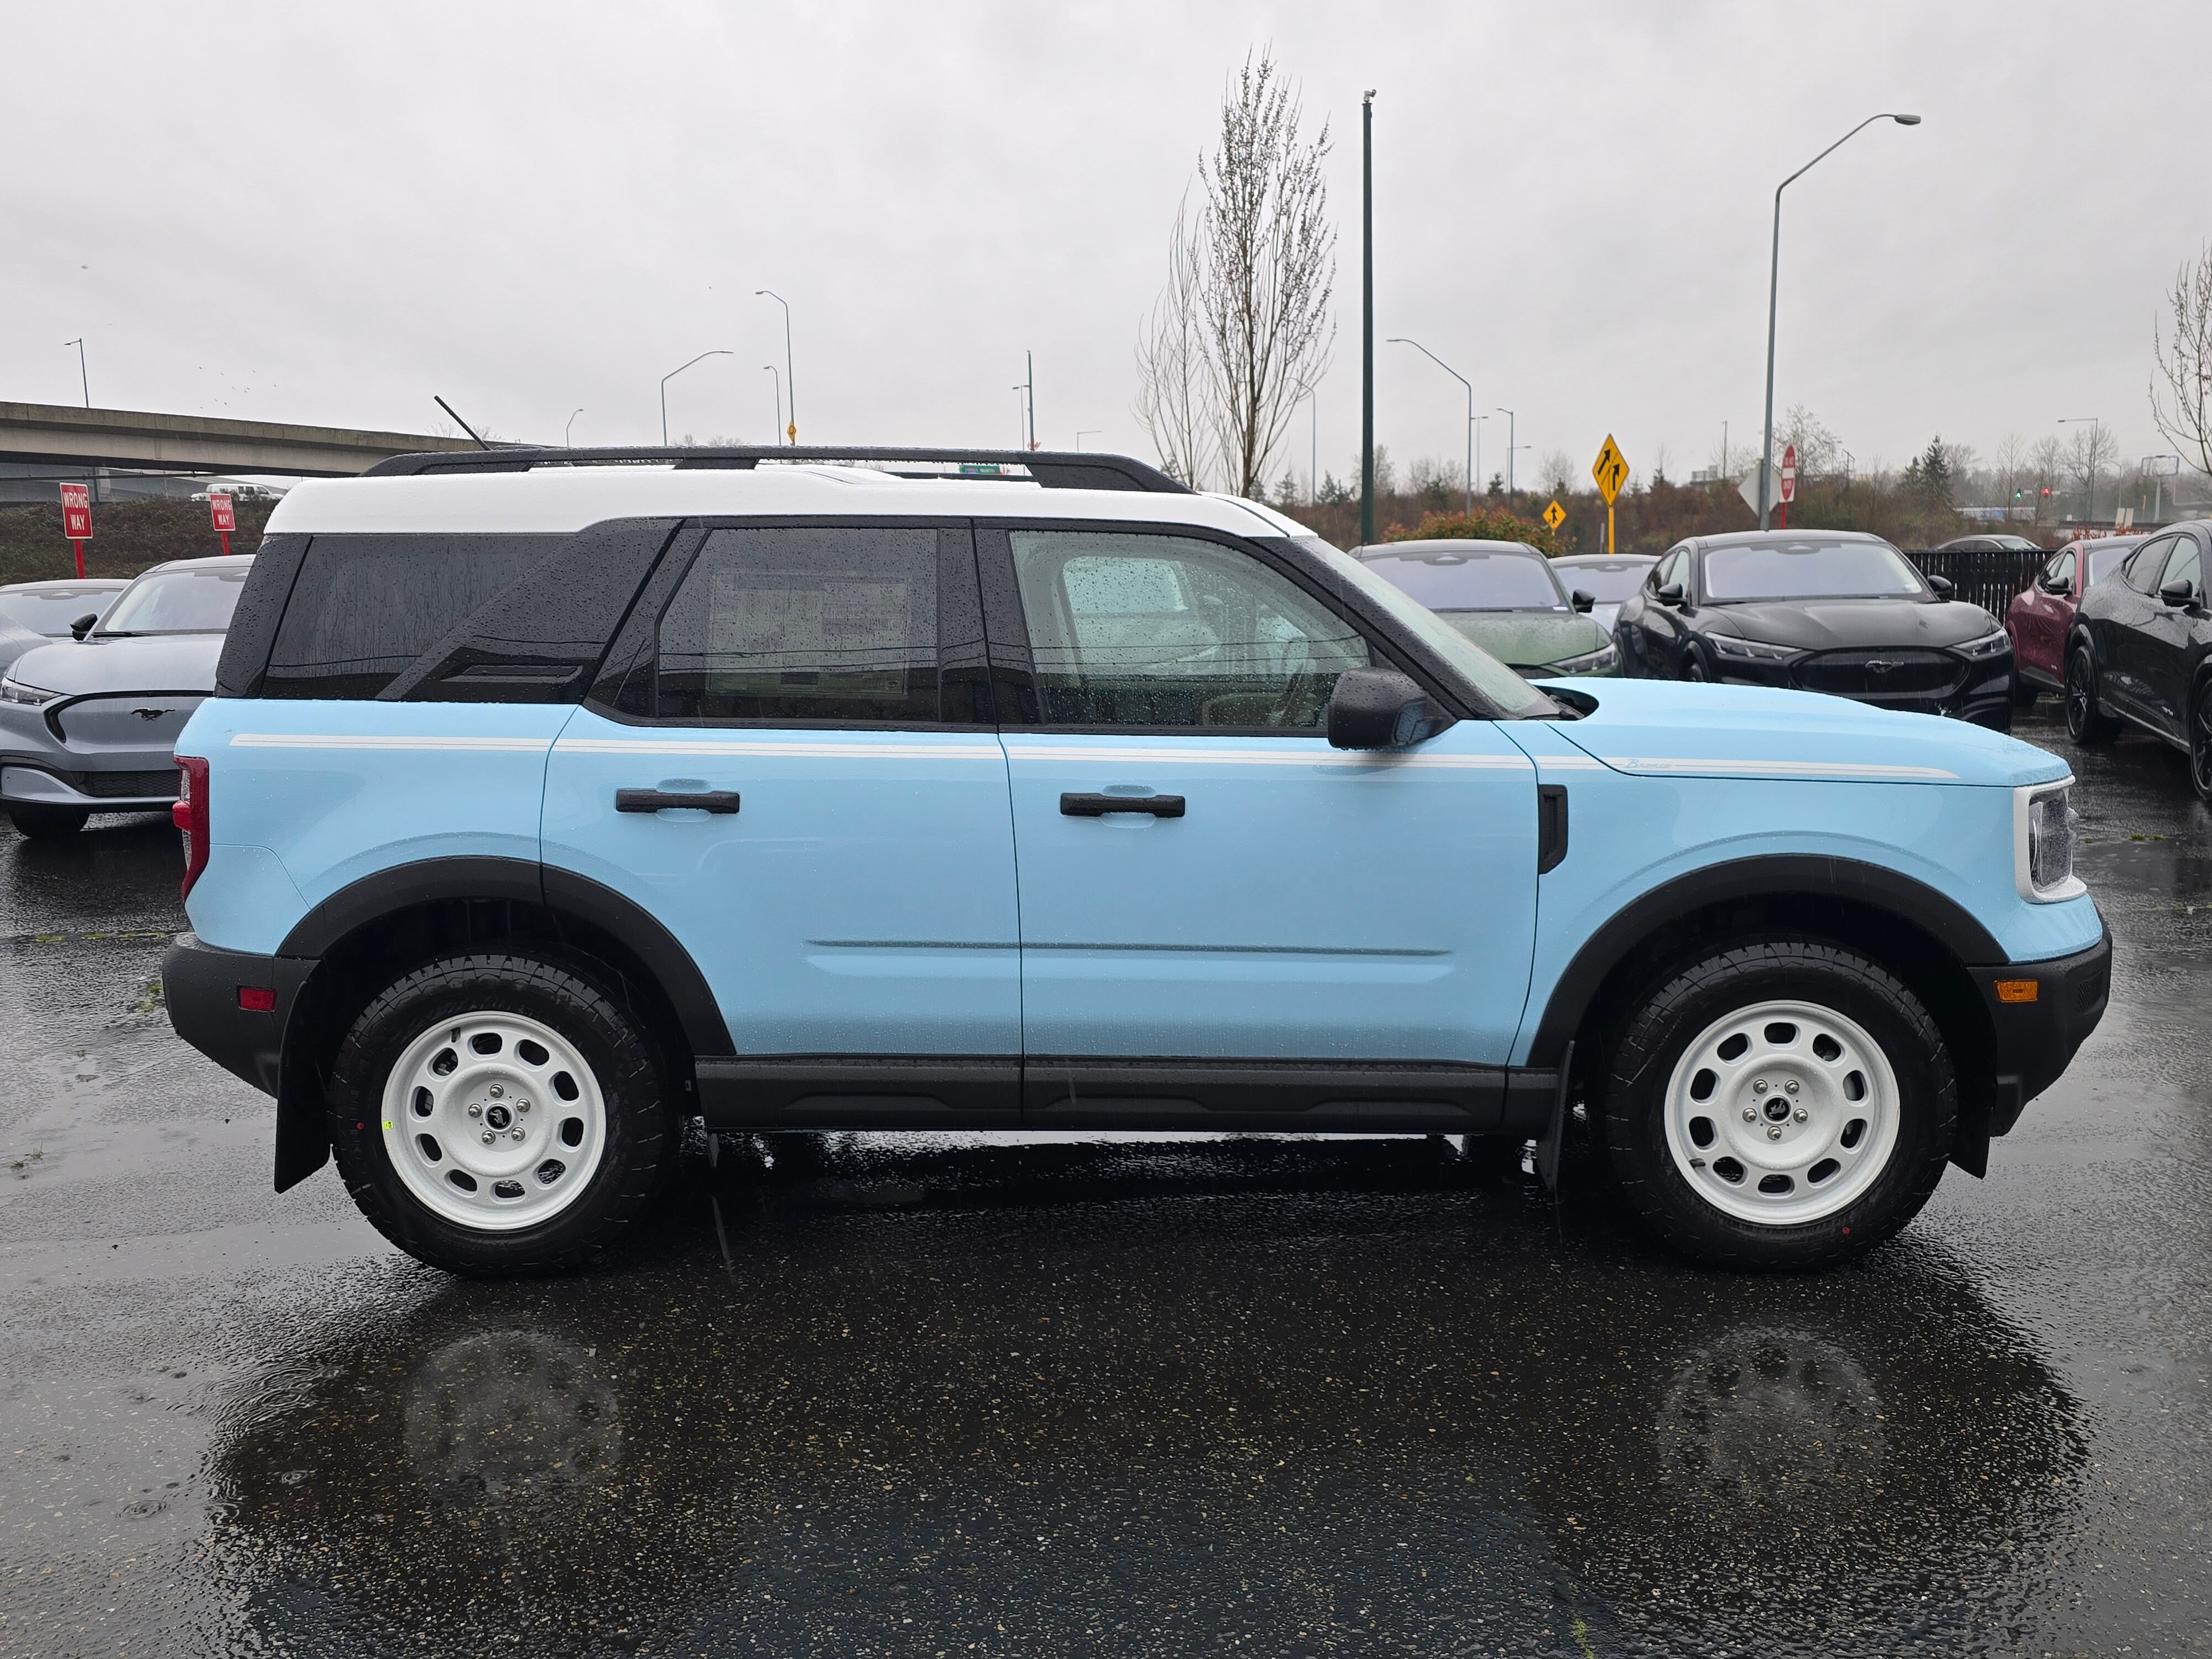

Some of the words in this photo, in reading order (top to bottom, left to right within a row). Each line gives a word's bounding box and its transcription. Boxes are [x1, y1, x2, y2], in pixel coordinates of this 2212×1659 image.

[63, 492, 87, 509] WRONG
[211, 499, 231, 510] WRONG
[70, 514, 85, 530] WAY
[217, 514, 229, 525] WAY
[1624, 759, 1672, 768] Bronco
